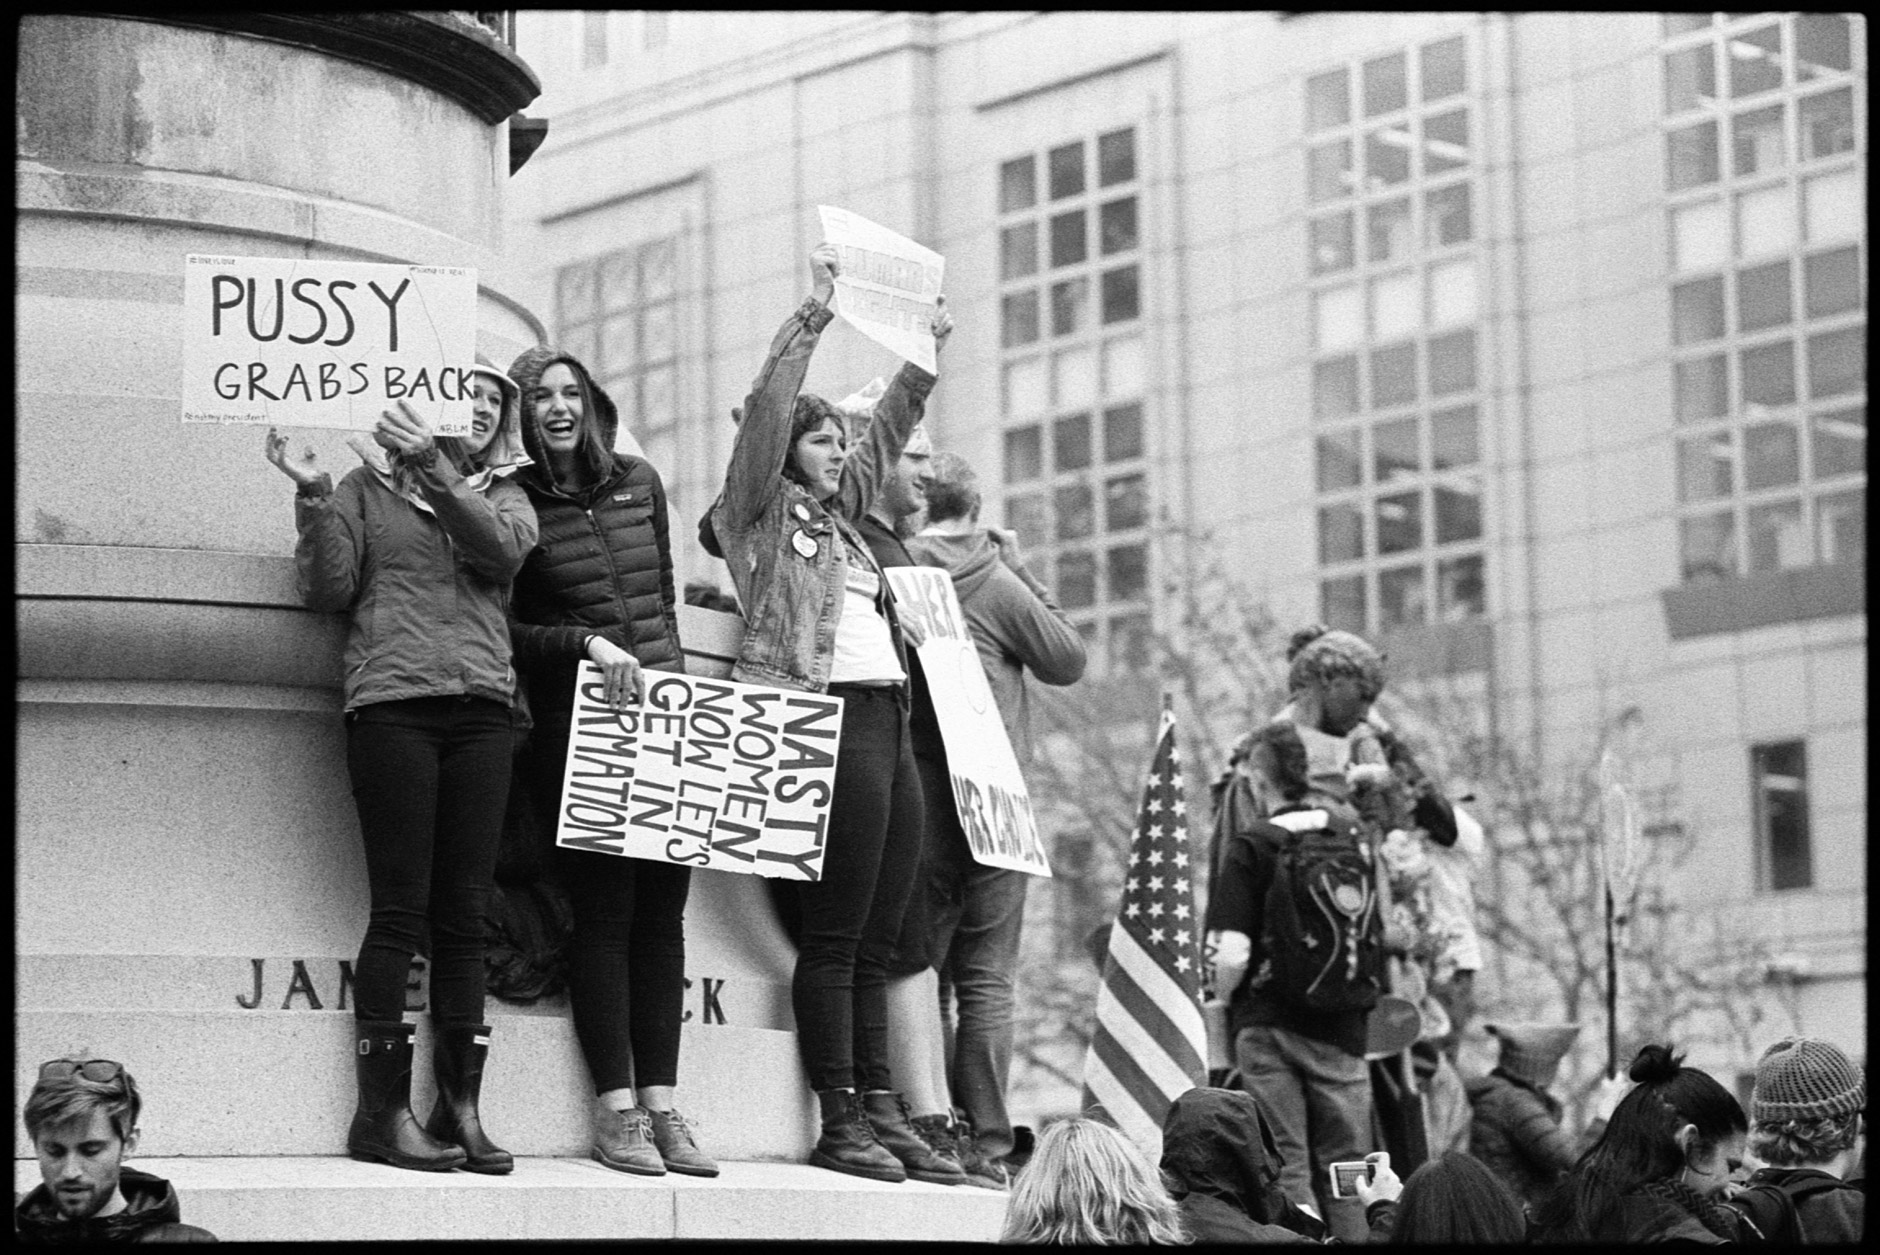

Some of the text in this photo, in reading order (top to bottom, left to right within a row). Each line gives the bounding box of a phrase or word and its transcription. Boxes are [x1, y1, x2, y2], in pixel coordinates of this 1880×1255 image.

[211, 274, 411, 353] PUSSY
[213, 362, 475, 402] GRABS BACK
[561, 665, 640, 854] ORMATION
[629, 677, 693, 833] GET IN
[665, 681, 735, 866] NOW LET'S
[710, 693, 782, 863] WOMEN
[756, 697, 839, 881] NASTY
